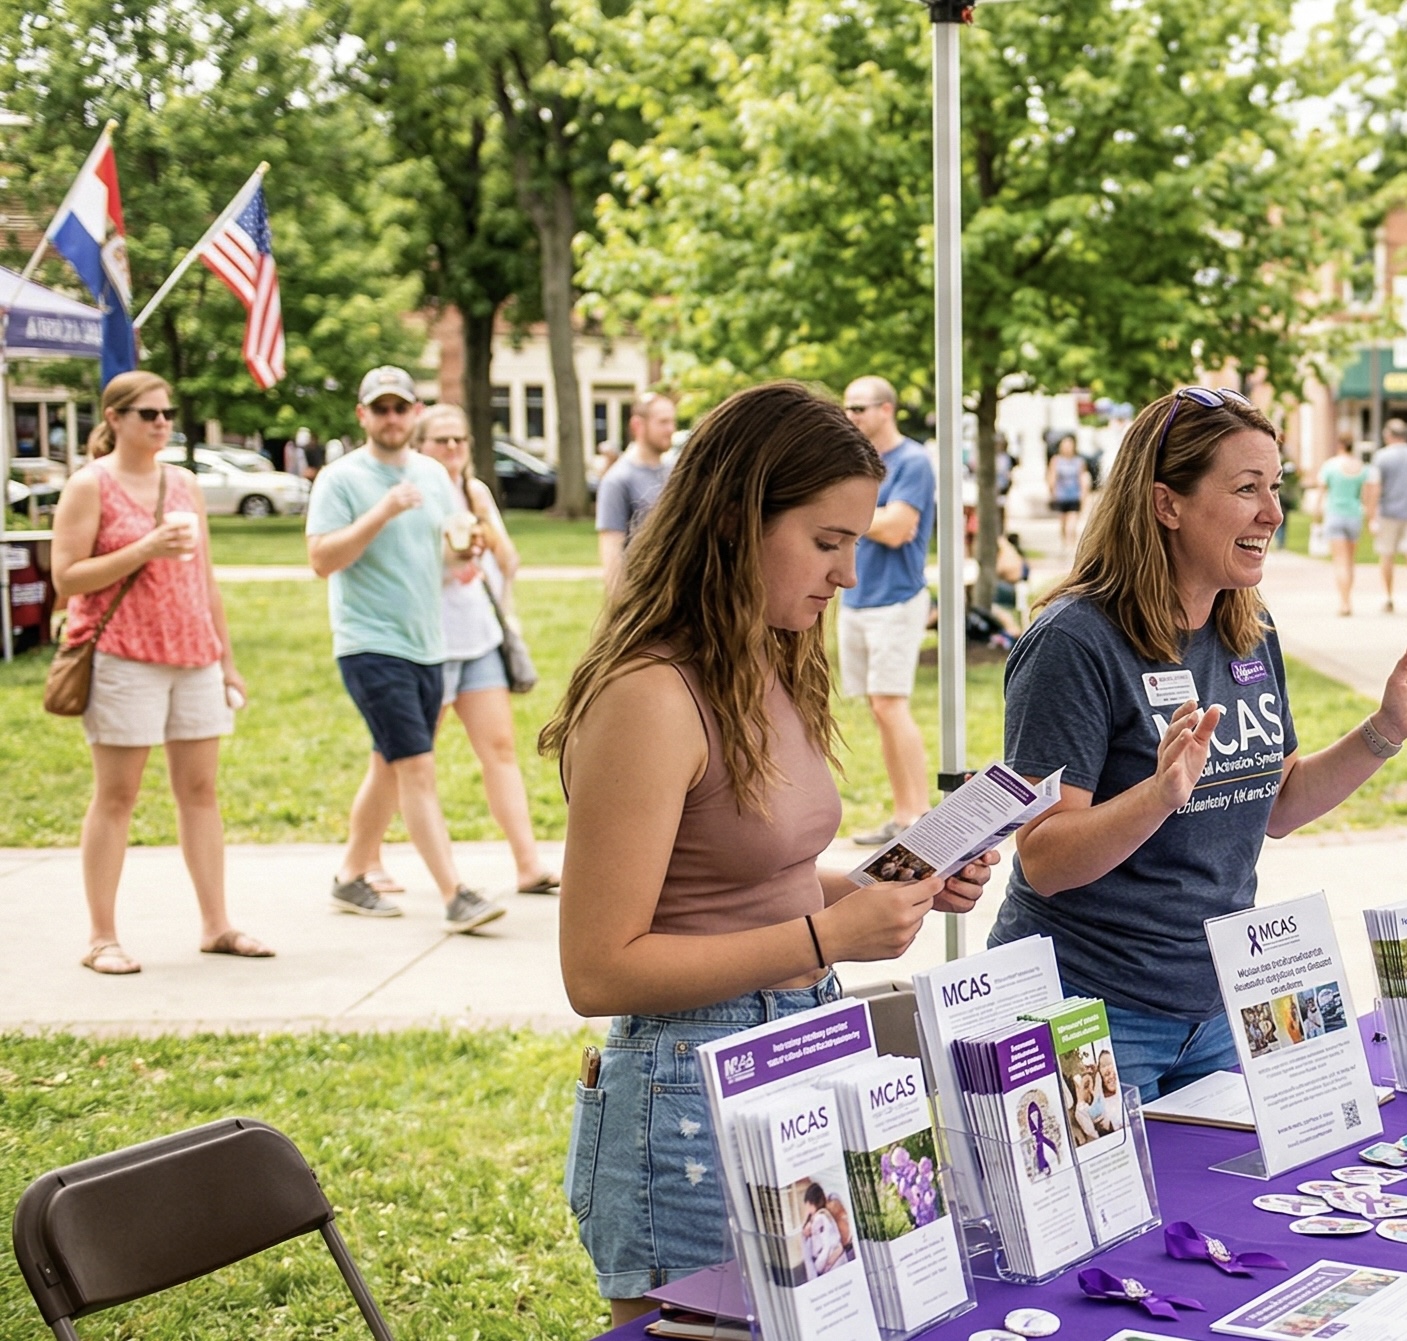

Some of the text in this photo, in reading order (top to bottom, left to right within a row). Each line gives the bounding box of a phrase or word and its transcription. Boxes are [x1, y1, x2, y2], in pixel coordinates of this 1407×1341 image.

[1259, 915, 1297, 942] MCAS
[942, 973, 991, 1008] MCAS
[869, 1074, 916, 1110] MCAS
[780, 1106, 829, 1143] MCAS
